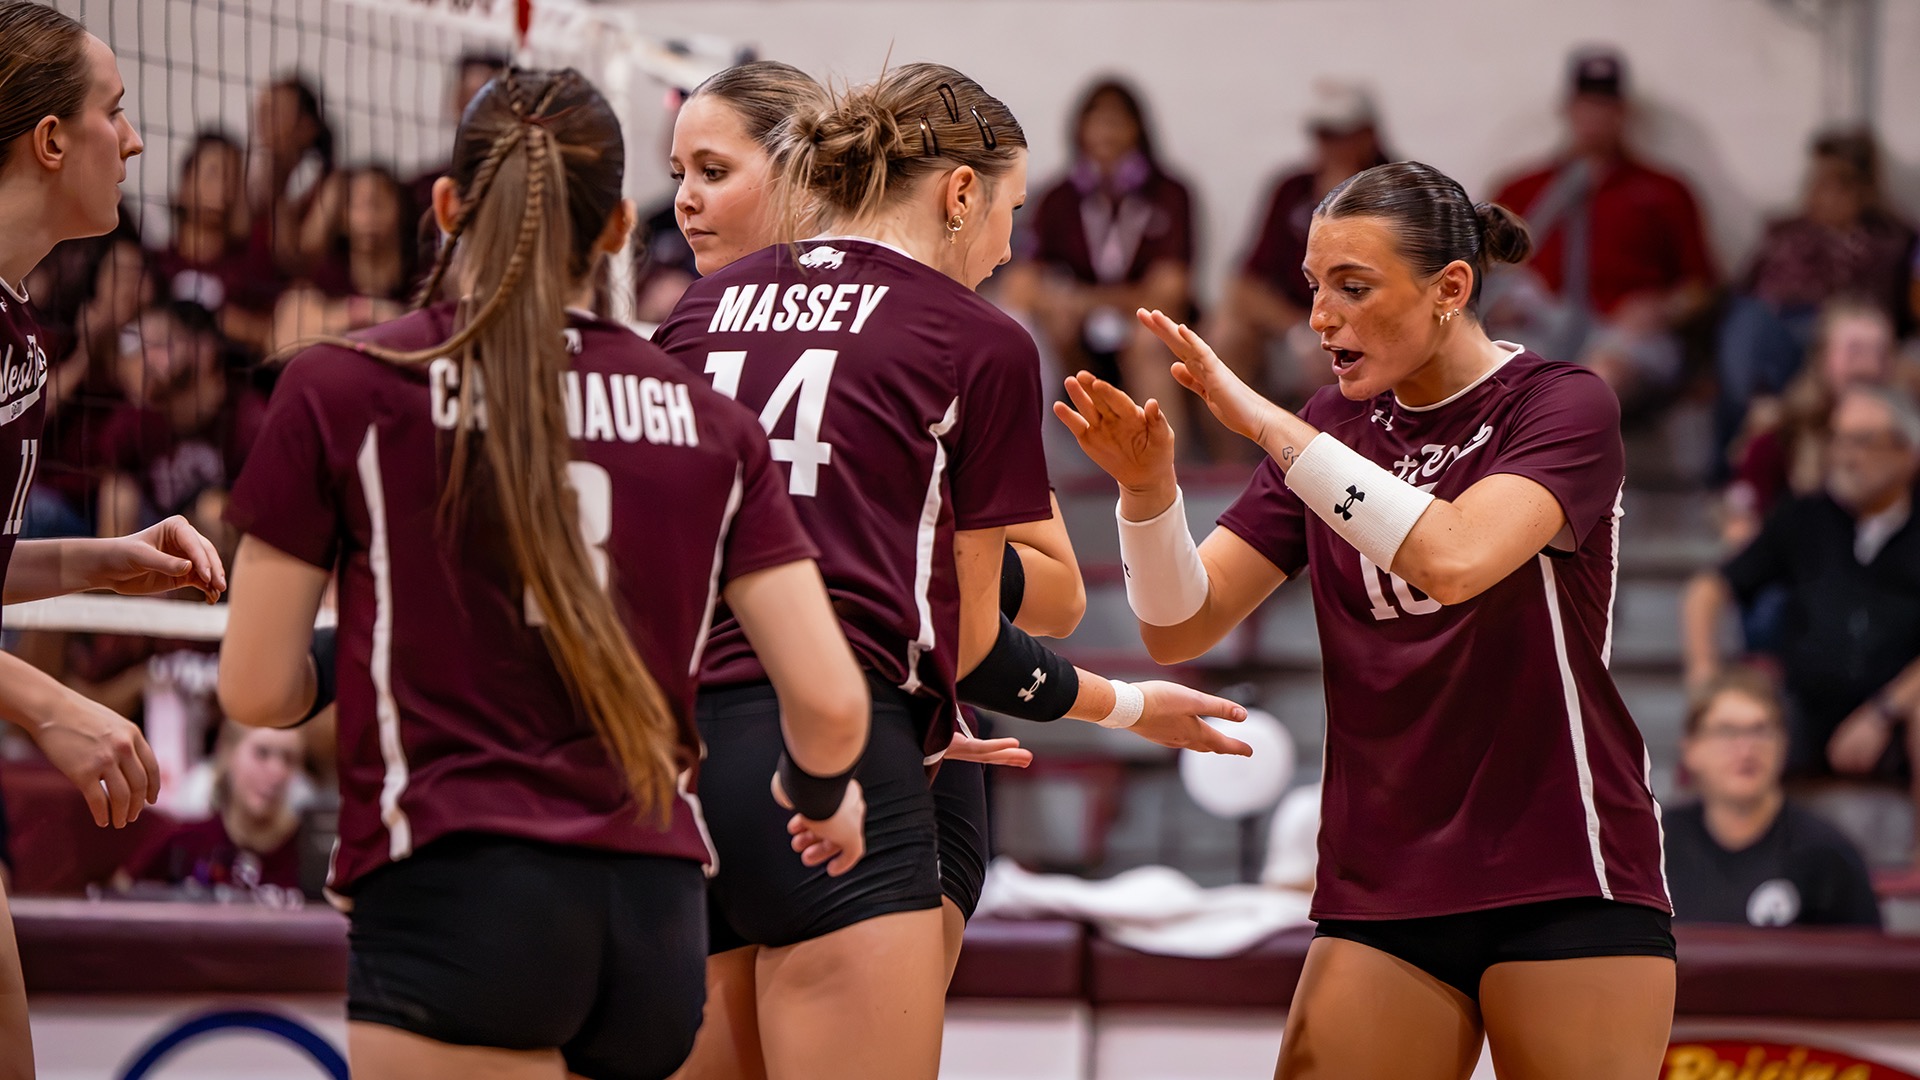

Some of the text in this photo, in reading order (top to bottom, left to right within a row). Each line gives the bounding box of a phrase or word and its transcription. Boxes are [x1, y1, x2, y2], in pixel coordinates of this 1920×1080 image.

[707, 283, 890, 334] MASSEY
[429, 358, 699, 447] CANAUGH
[2, 439, 38, 535] 11
